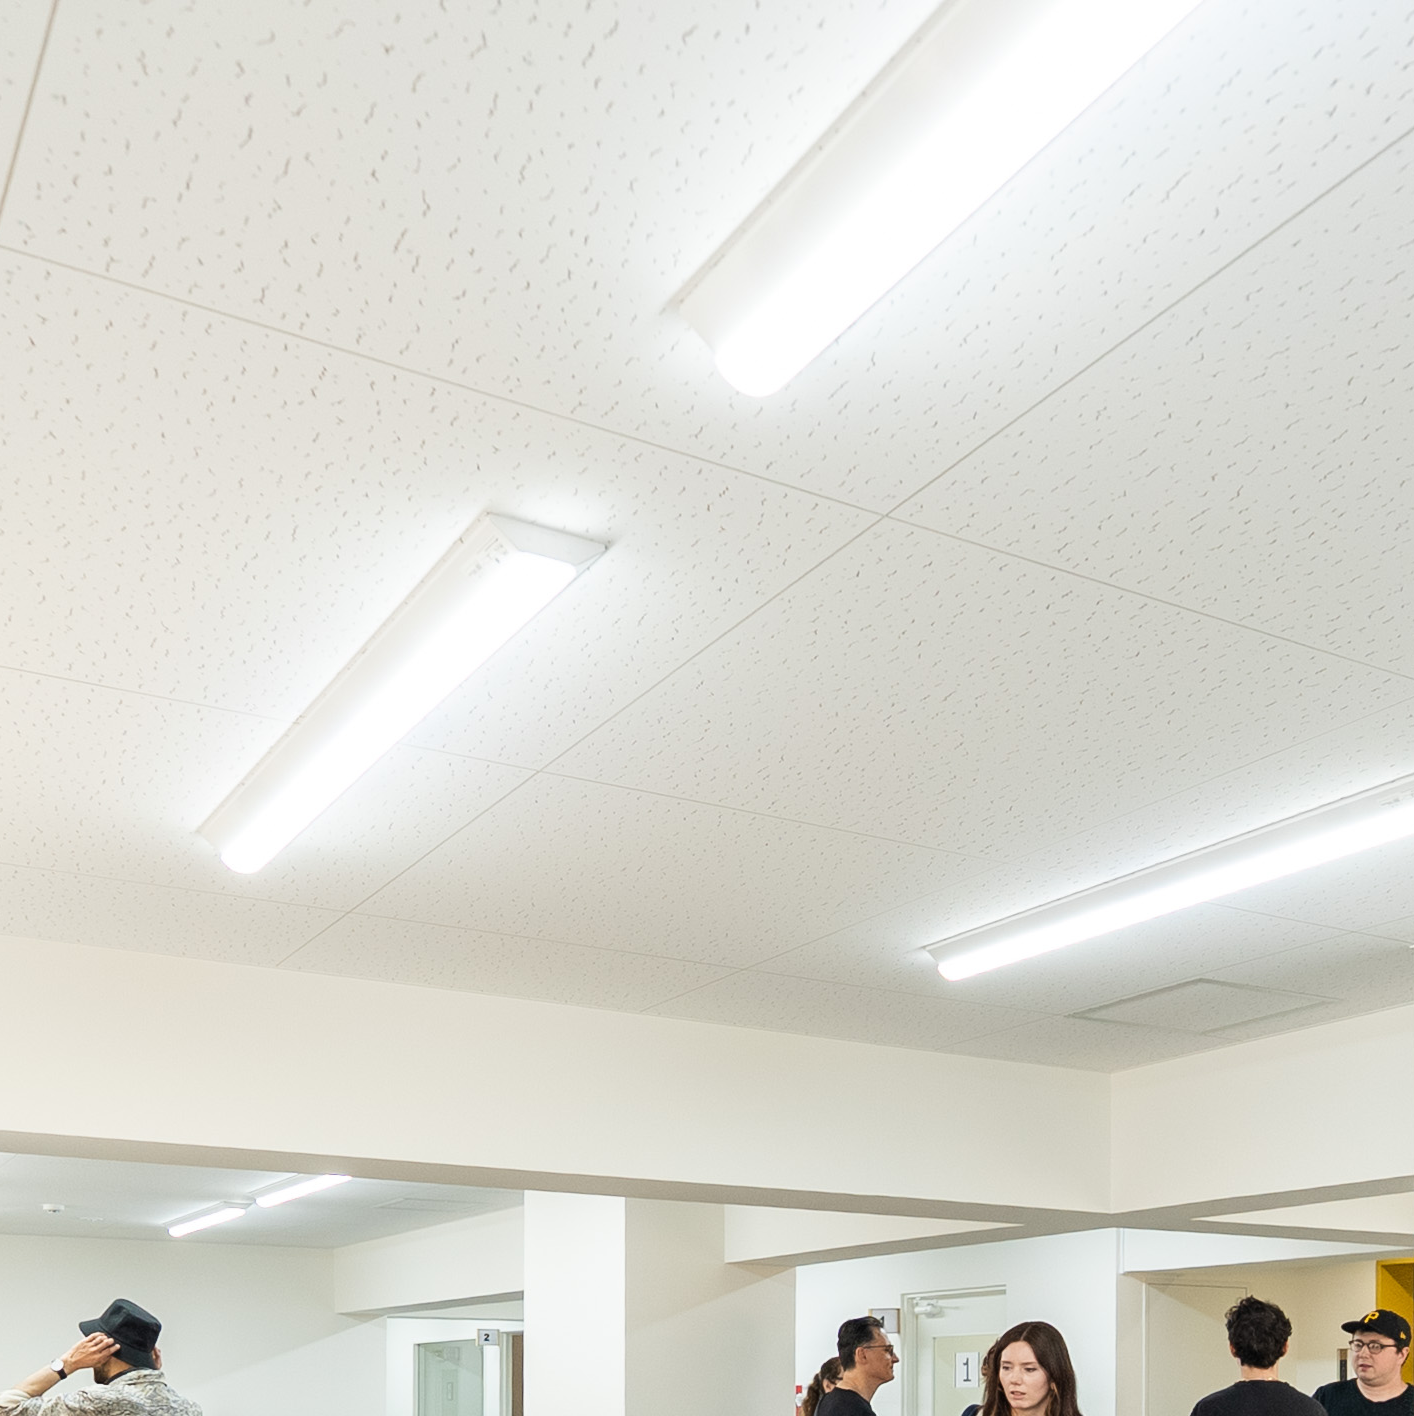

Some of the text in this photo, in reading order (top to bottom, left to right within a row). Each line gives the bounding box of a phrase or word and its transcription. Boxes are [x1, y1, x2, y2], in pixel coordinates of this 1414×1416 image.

[1364, 1311, 1380, 1324] P
[483, 1333, 490, 1342] 2
[962, 1357, 972, 1382] 1
